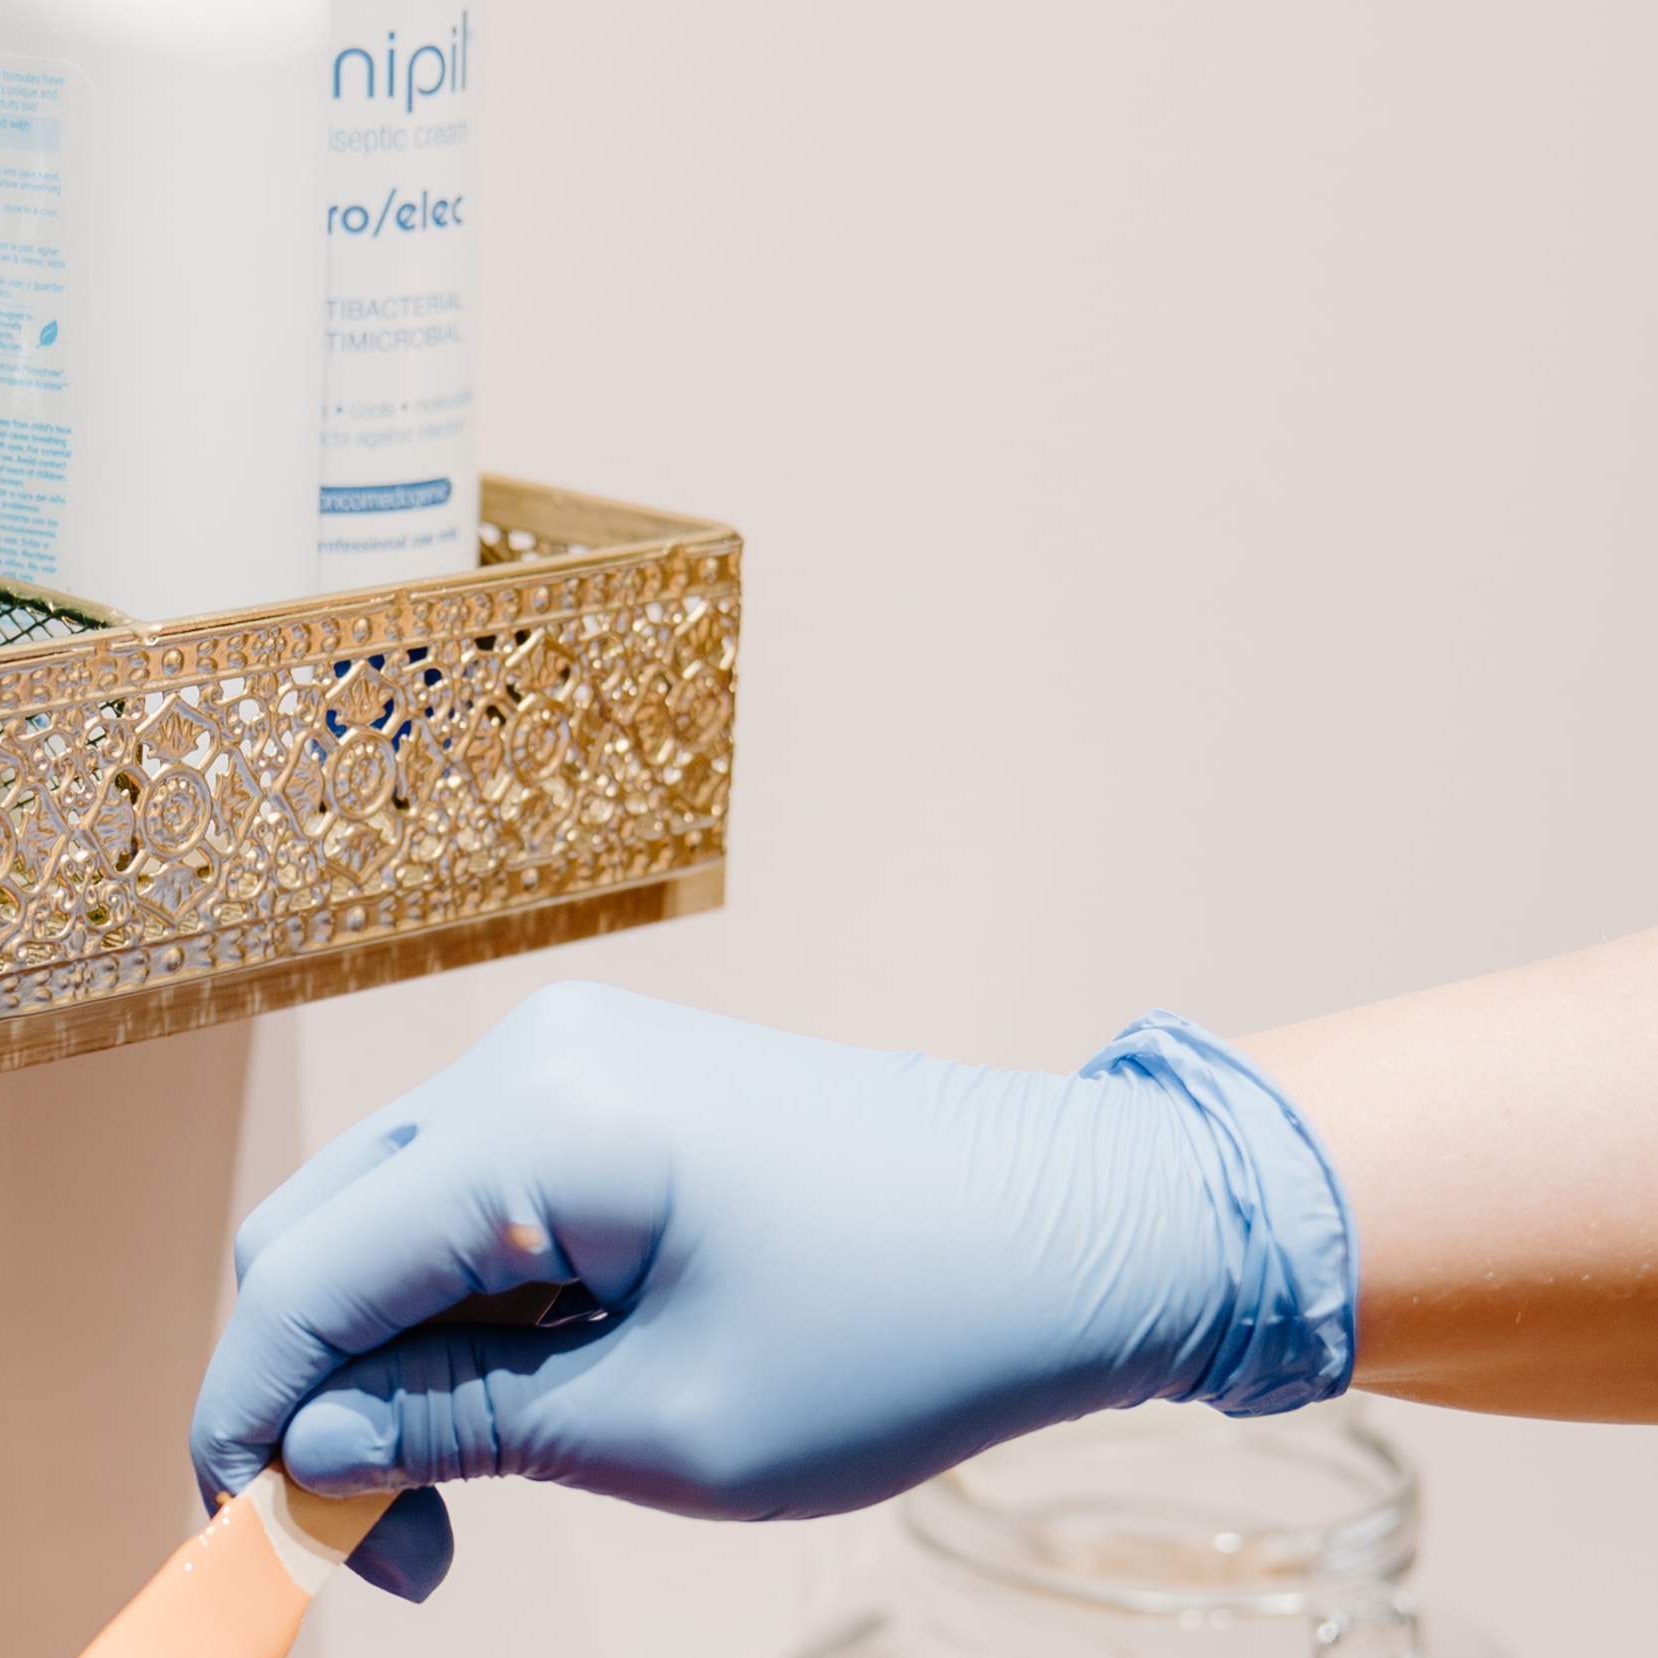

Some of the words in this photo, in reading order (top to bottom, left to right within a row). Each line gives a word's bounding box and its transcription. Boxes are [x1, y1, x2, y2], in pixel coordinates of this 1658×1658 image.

[333, 9, 468, 114] nipil
[2, 69, 40, 85] formulas
[42, 72, 65, 86] have
[7, 85, 38, 100] unique
[39, 88, 58, 100] and
[8, 118, 31, 133] with
